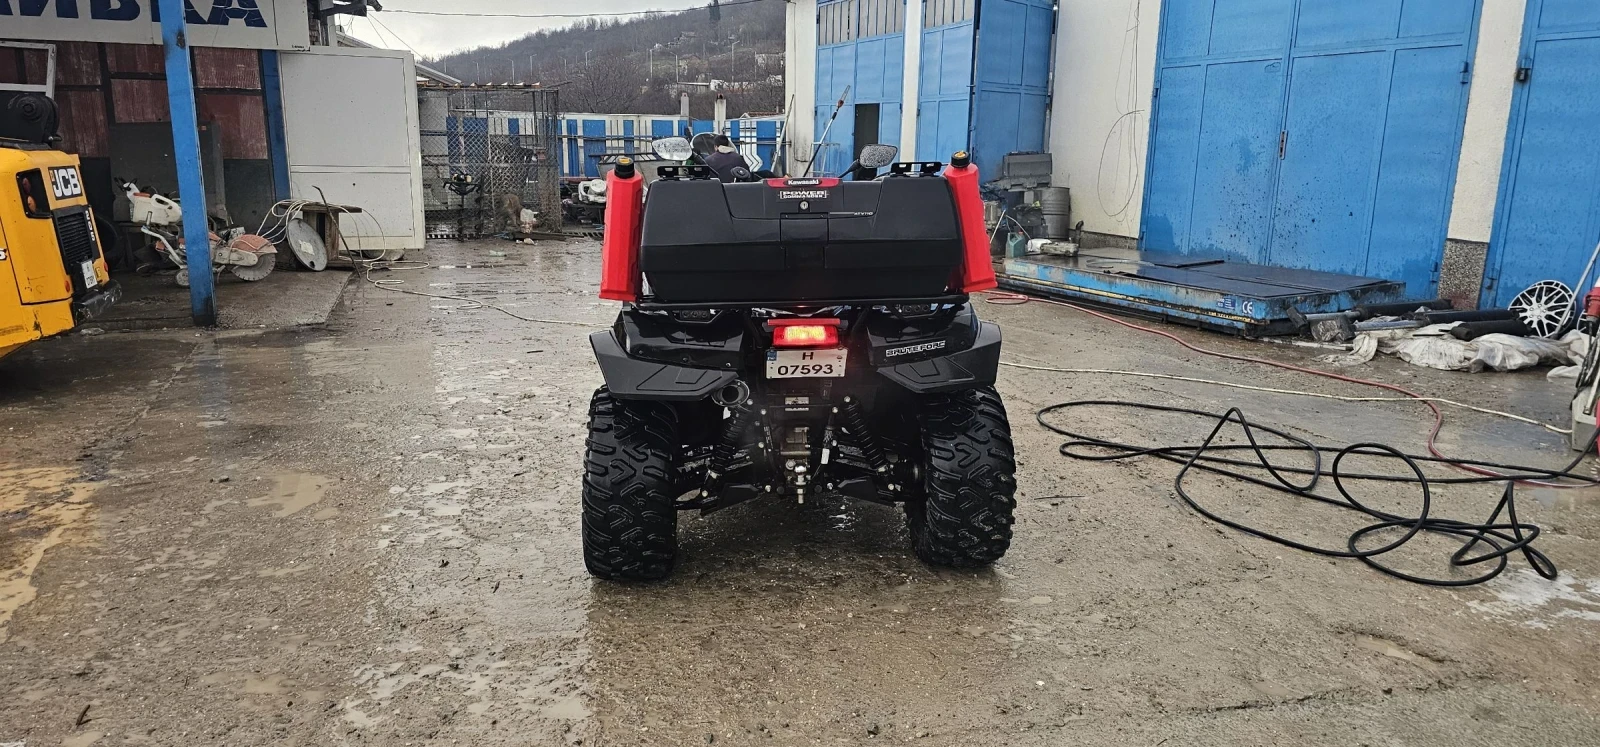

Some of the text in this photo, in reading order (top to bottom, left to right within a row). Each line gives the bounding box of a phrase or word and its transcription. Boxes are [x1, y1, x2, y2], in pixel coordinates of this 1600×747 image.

[53, 168, 81, 197] JCB
[802, 352, 814, 360] H
[886, 346, 919, 357] BRUTE
[777, 363, 834, 376] 07593
